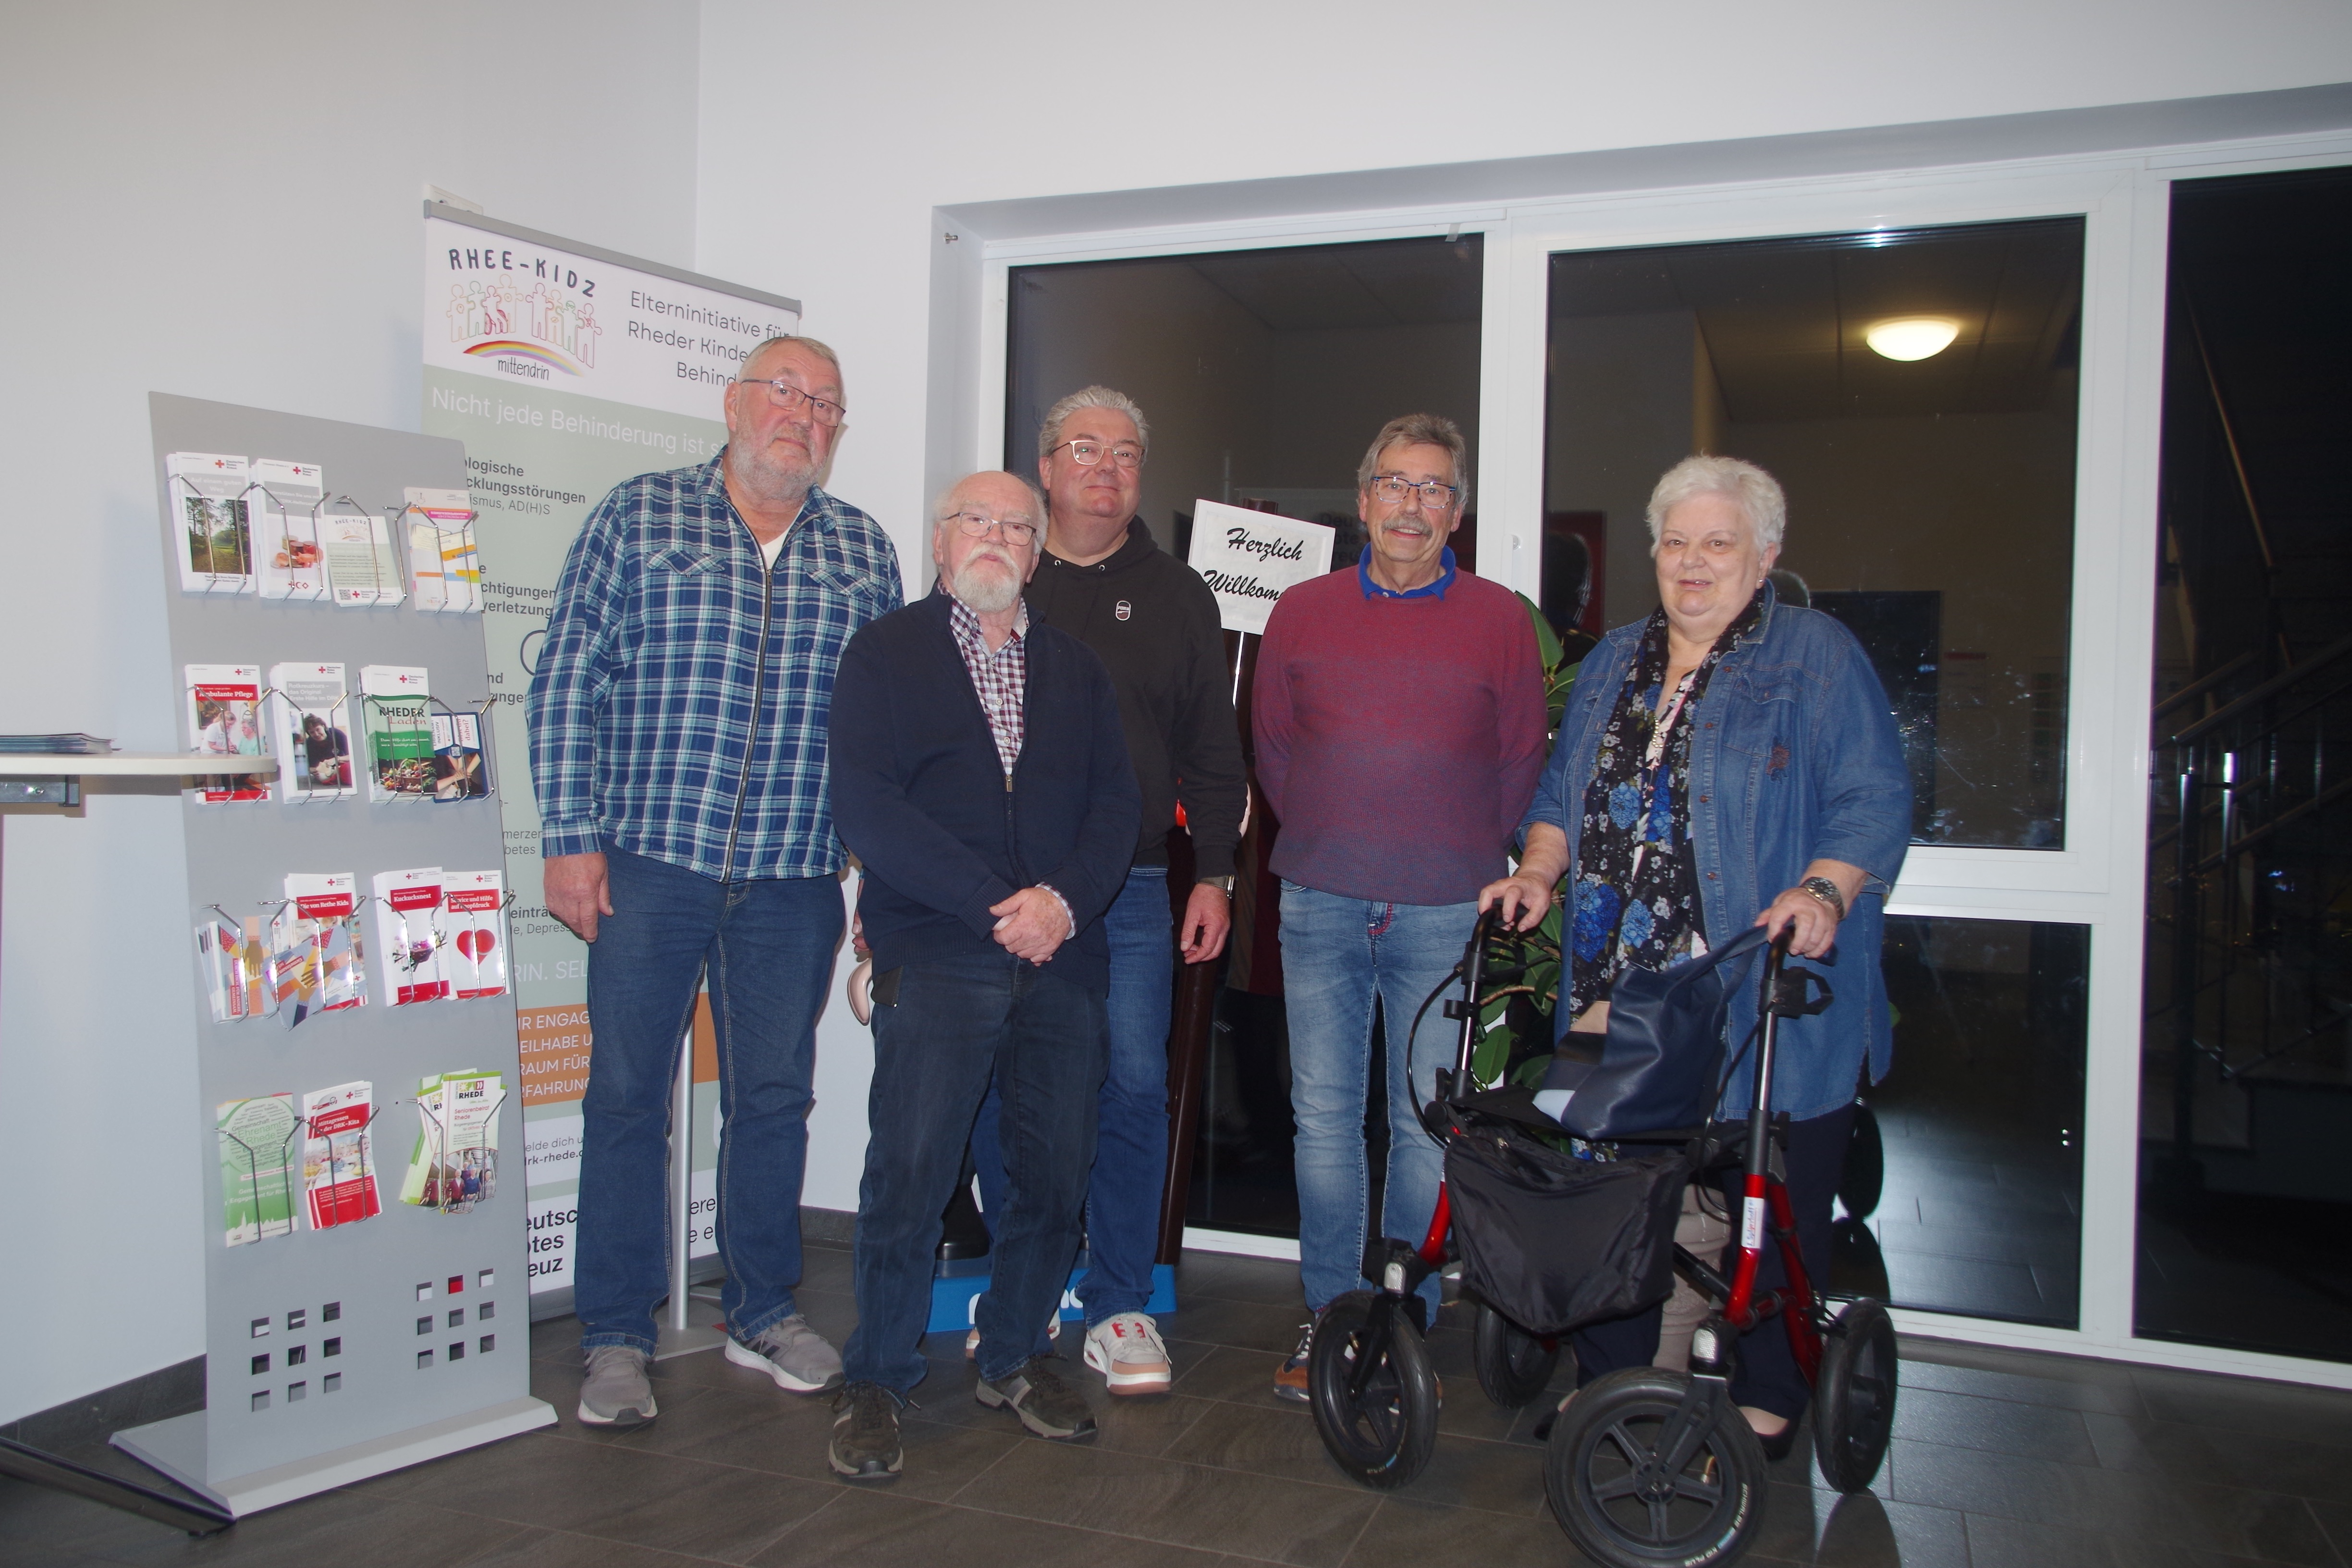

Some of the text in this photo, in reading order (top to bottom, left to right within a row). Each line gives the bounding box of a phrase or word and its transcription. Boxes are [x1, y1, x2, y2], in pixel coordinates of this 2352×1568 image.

[449, 248, 596, 298] RHEE-KIDZ
[631, 291, 761, 337] Elterninitiative
[628, 320, 748, 362] Rheder Kinde
[498, 356, 550, 381] mittendrin
[677, 362, 736, 386] Behind
[433, 386, 491, 417] Nicht
[496, 398, 544, 426] jede
[552, 409, 677, 454] Behinderung
[683, 437, 704, 454] ist
[466, 476, 586, 504] cklungsstörungen
[469, 494, 504, 511] ismus,
[508, 500, 551, 515] AD(H)S
[1226, 527, 1304, 562] Herzlich
[481, 580, 556, 600] chtigungen
[483, 600, 553, 620] verletzung
[379, 707, 426, 718] RHEDER
[389, 716, 427, 725] Laden
[502, 830, 542, 841] merze
[504, 845, 536, 855] betes
[394, 894, 432, 902] Kuckucksnest
[510, 905, 549, 919] einträ
[527, 923, 572, 935] Depress
[514, 960, 588, 982] RIN. SEL
[518, 1010, 590, 1030] IR ENGAG
[520, 1034, 593, 1054] EILHABE U
[520, 1054, 590, 1076] RAUM FÜR
[459, 1090, 484, 1099] RHEDE
[454, 1105, 490, 1114] Seniorenbeirat
[232, 1118, 270, 1132] Gemeinschaft
[318, 1115, 349, 1127] Mittagessen
[333, 1119, 360, 1129] DRK-Kita
[238, 1122, 282, 1139] Ehrenamt
[246, 1133, 276, 1145] Rhede
[525, 1137, 549, 1153] elde
[551, 1135, 576, 1147] dich
[524, 1149, 583, 1166] rk-rhede.
[526, 1197, 716, 1232] eutsc ere
[528, 1256, 564, 1277] euz
[1684, 1554, 1705, 1567] PLUS
[1705, 1546, 1718, 1558] KID
